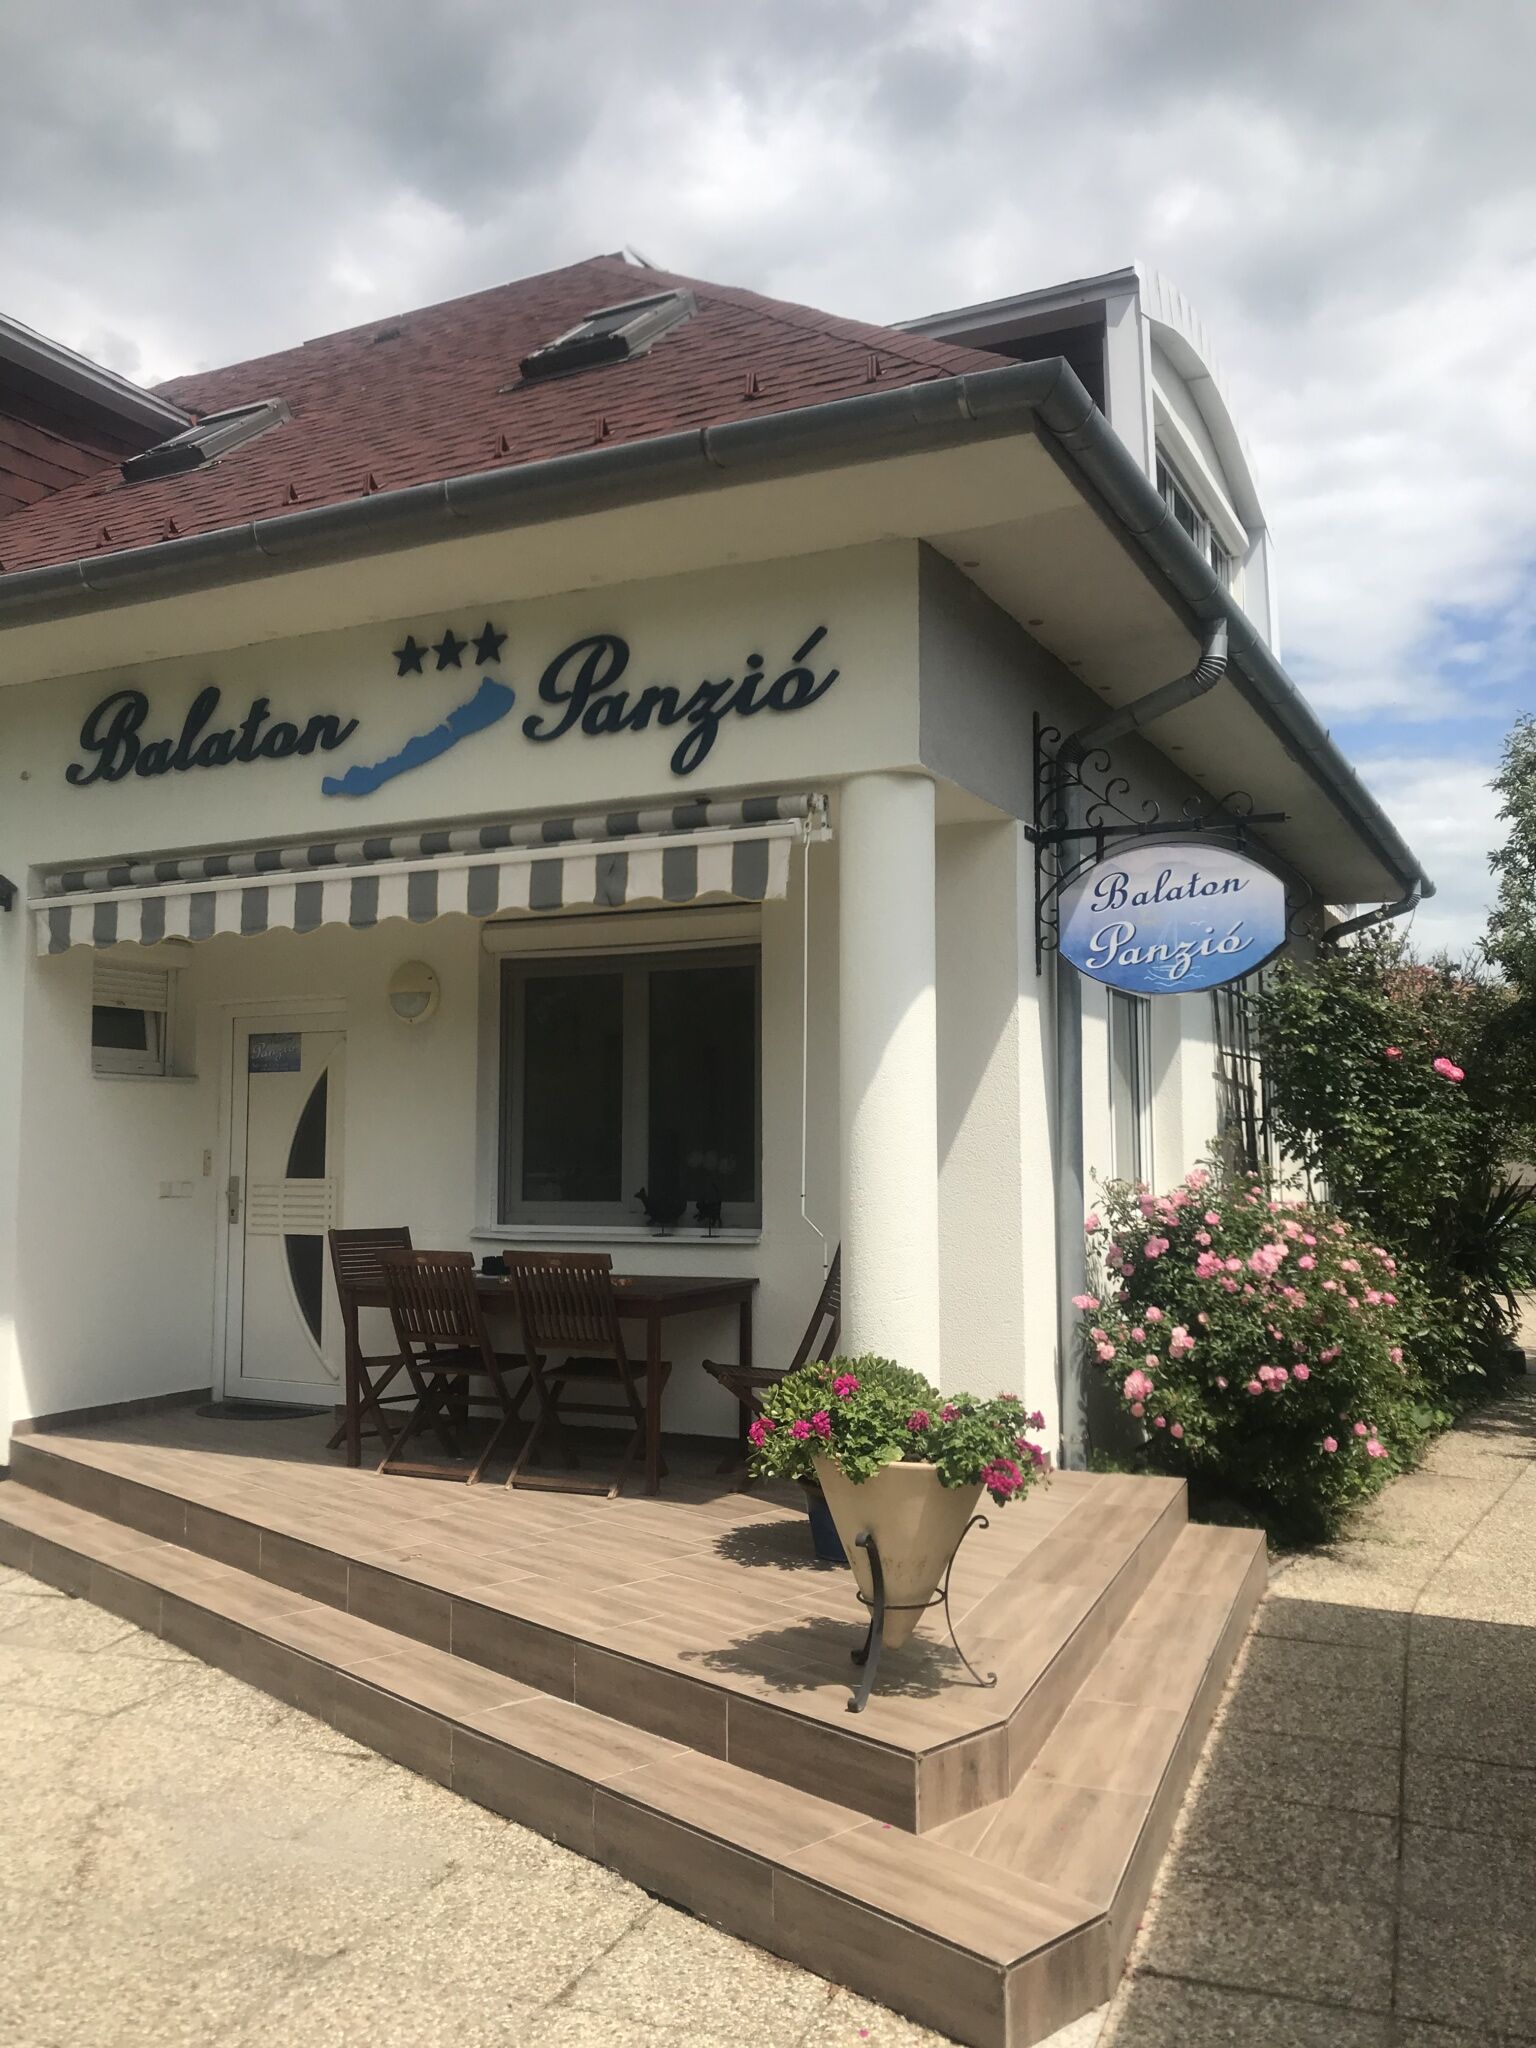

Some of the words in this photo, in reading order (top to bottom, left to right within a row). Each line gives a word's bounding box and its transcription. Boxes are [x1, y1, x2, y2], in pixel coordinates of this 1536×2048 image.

[66, 687, 360, 787] Balaton
[522, 624, 841, 777] Panzió
[1090, 868, 1250, 913] Balaton
[1085, 920, 1255, 981] Panzió
